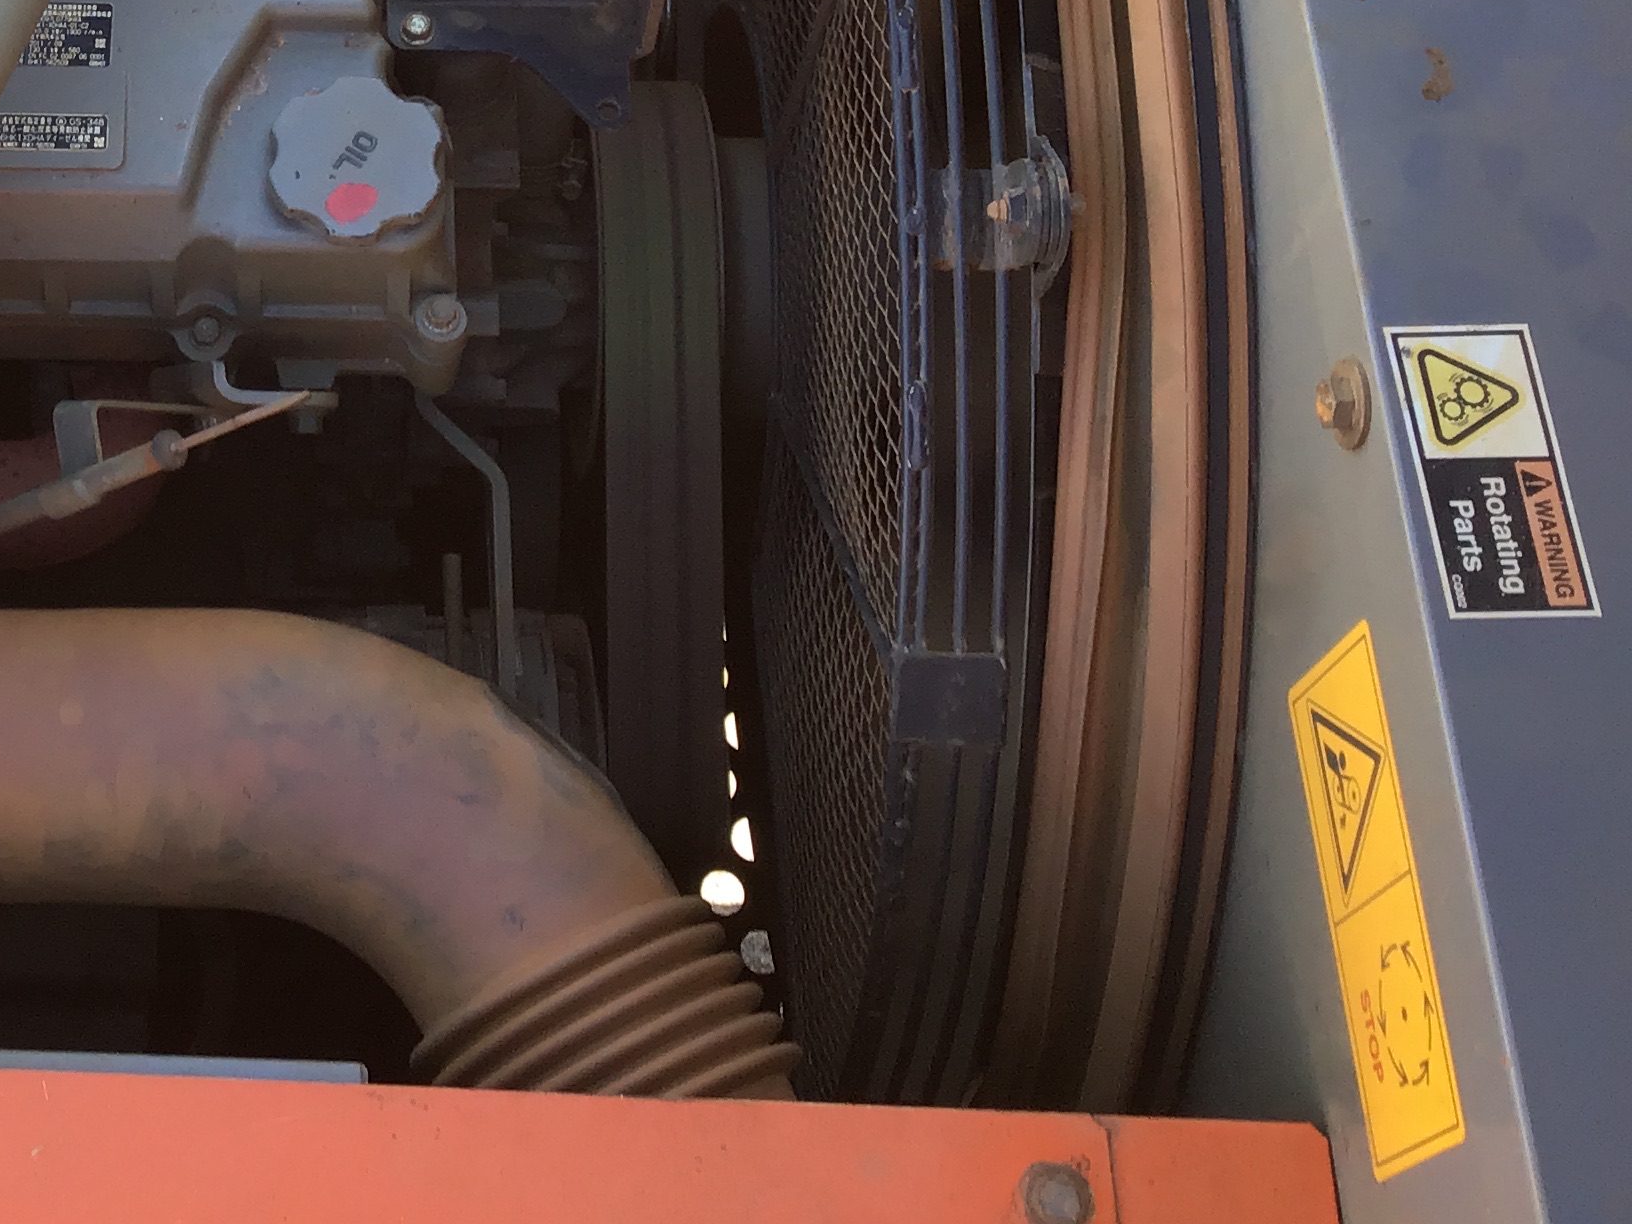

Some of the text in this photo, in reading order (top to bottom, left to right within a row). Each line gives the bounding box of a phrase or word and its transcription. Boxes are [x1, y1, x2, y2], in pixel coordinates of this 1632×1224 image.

[332, 131, 378, 170] OIL
[1449, 500, 1483, 572] Parts
[1480, 477, 1525, 594] Rotating
[1534, 500, 1575, 599] WARNING
[1361, 989, 1384, 1083] STOP
